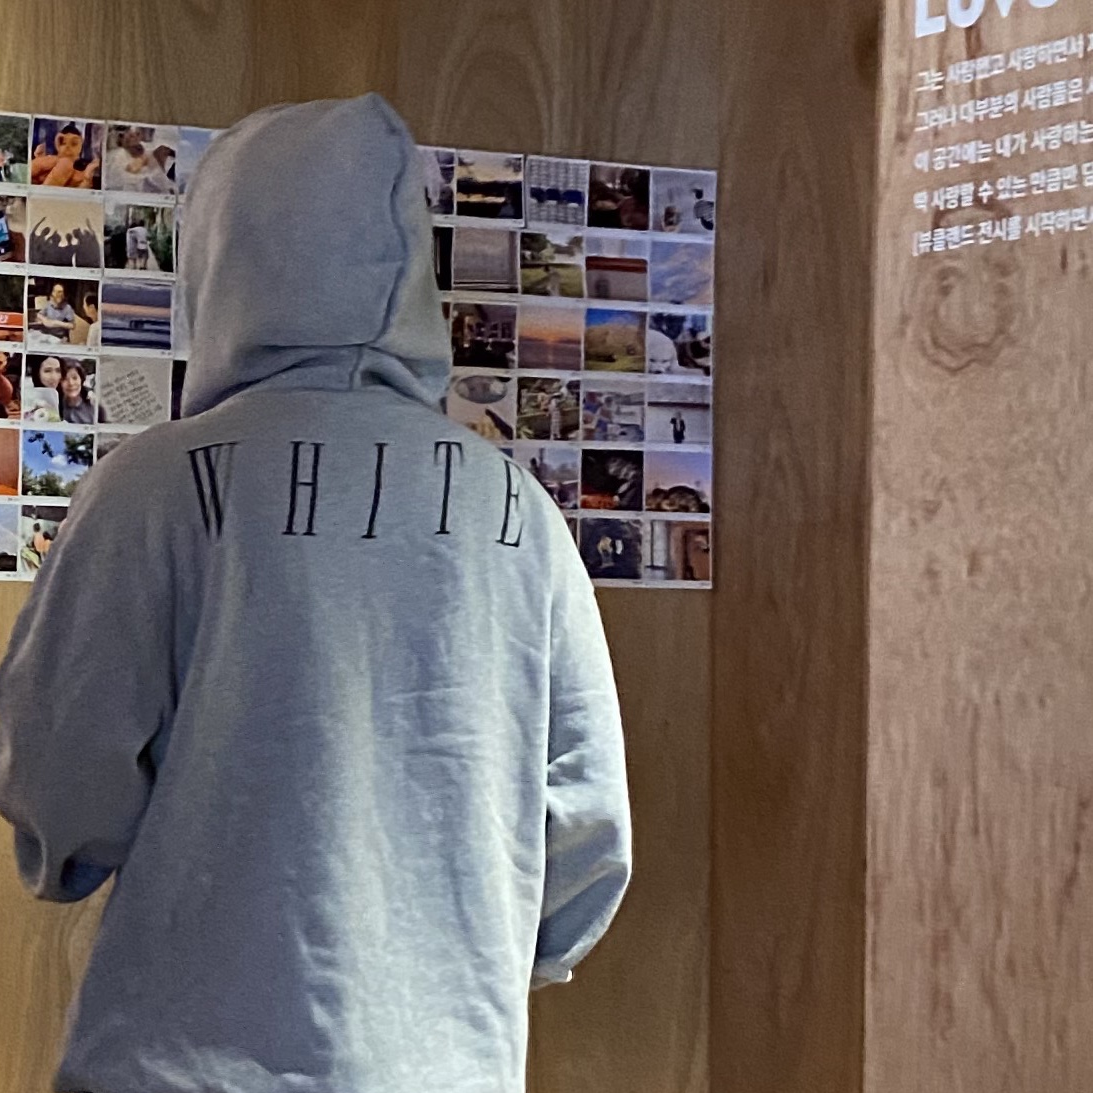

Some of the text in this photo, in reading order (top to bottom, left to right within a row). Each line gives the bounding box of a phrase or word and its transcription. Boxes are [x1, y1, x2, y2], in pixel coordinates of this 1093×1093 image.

[960, 90, 1019, 123] 대부분의
[996, 131, 1027, 158] 내가
[978, 181, 994, 203] 수
[997, 175, 1026, 201] 있는
[978, 215, 1022, 245] 전시를
[186, 440, 525, 548] WHITE
